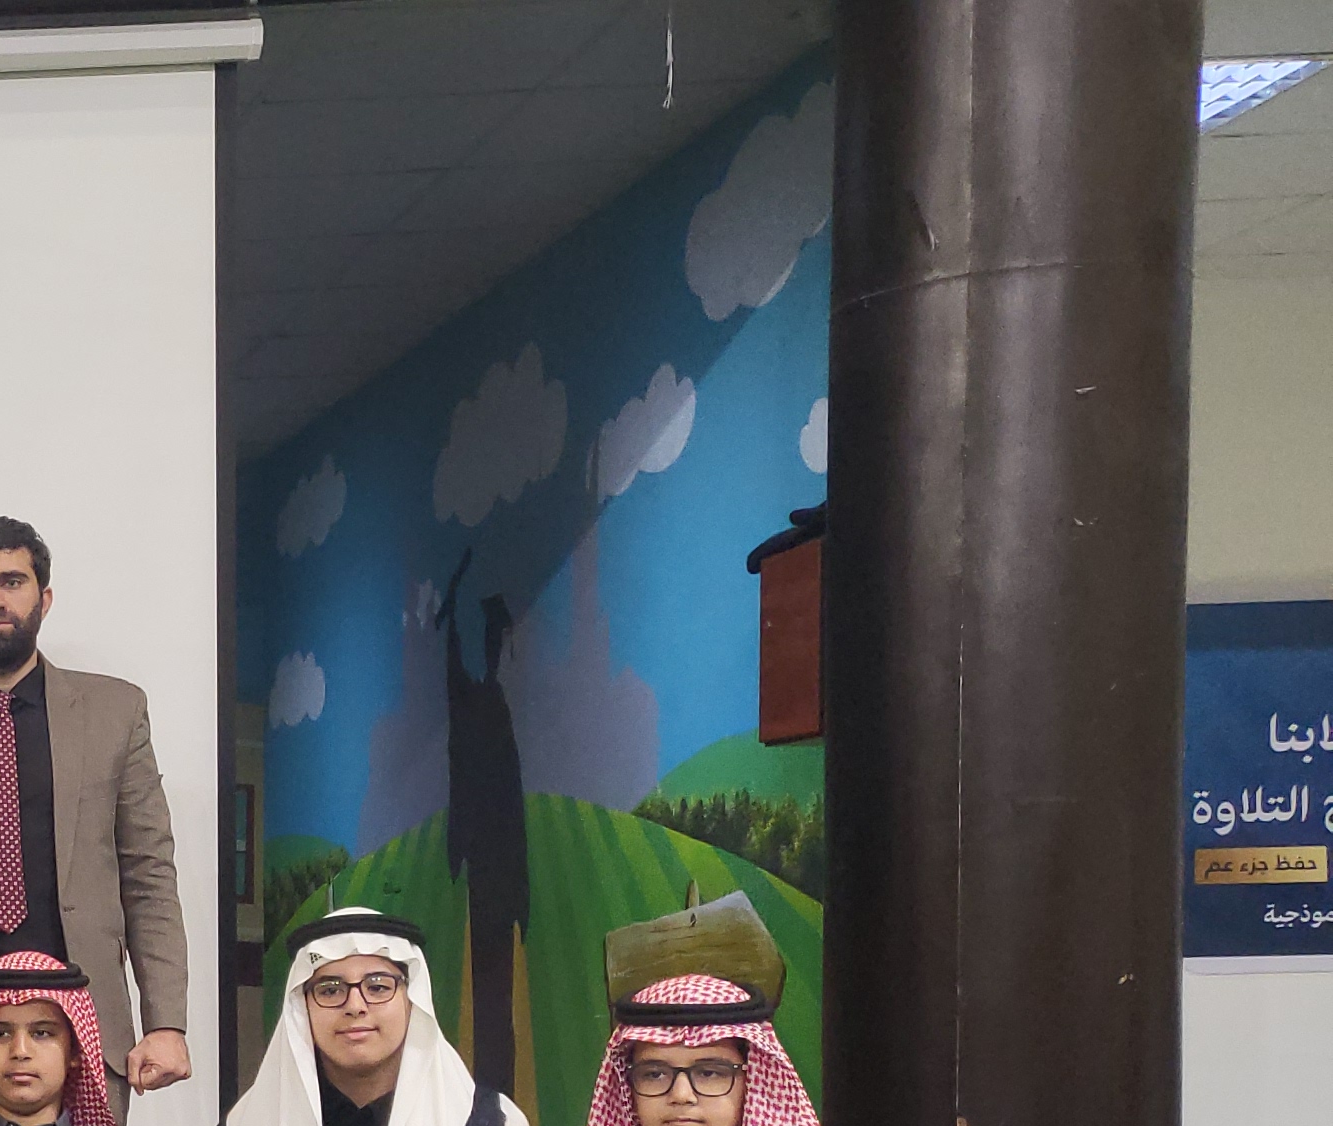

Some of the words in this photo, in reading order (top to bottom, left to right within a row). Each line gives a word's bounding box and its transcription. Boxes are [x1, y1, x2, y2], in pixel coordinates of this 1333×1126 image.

[1193, 784, 1309, 836] التلاوة
[1204, 862, 1233, 879] عم
[1240, 857, 1268, 875] جزء
[1275, 855, 1317, 870] حفظ
